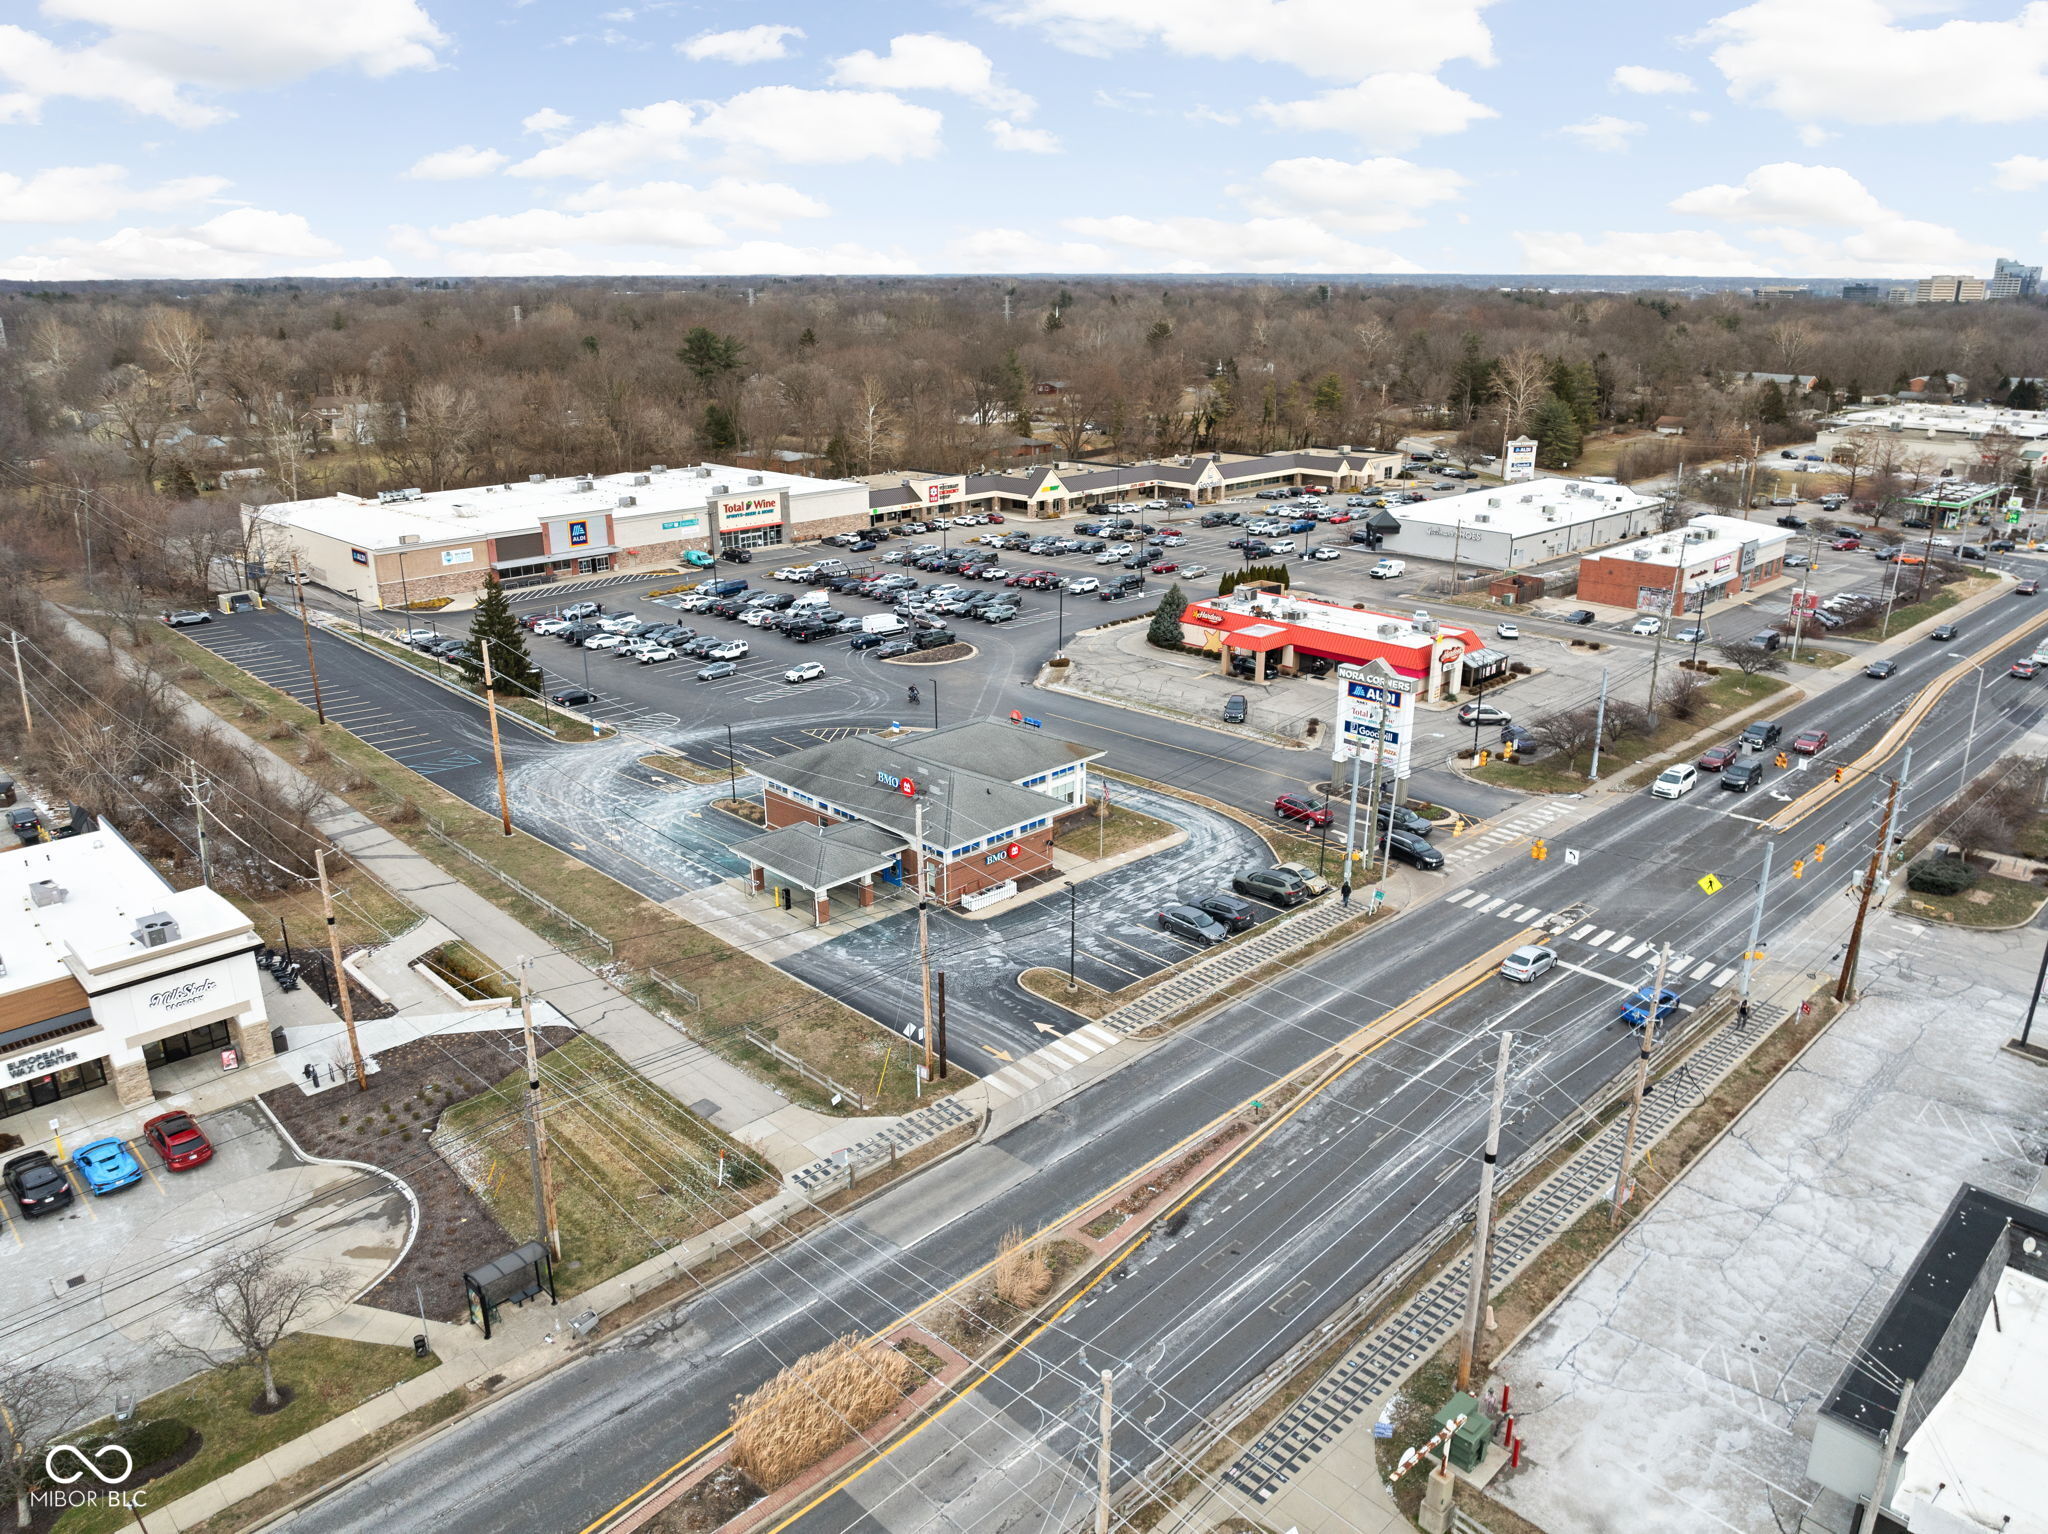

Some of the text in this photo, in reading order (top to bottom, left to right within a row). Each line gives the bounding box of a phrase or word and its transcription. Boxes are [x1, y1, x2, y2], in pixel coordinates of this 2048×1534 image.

[723, 499, 776, 513] Total Wine
[1339, 668, 1411, 692] NORA CORNERS
[1352, 707, 1369, 718] Total
[1359, 726, 1393, 741] Goodill
[878, 771, 899, 788] BMO
[985, 850, 1008, 865] BMO
[166, 995, 205, 1012] FACTORY
[7, 1047, 64, 1071] EUROPEAN
[9, 1052, 78, 1079] WAX CENTER
